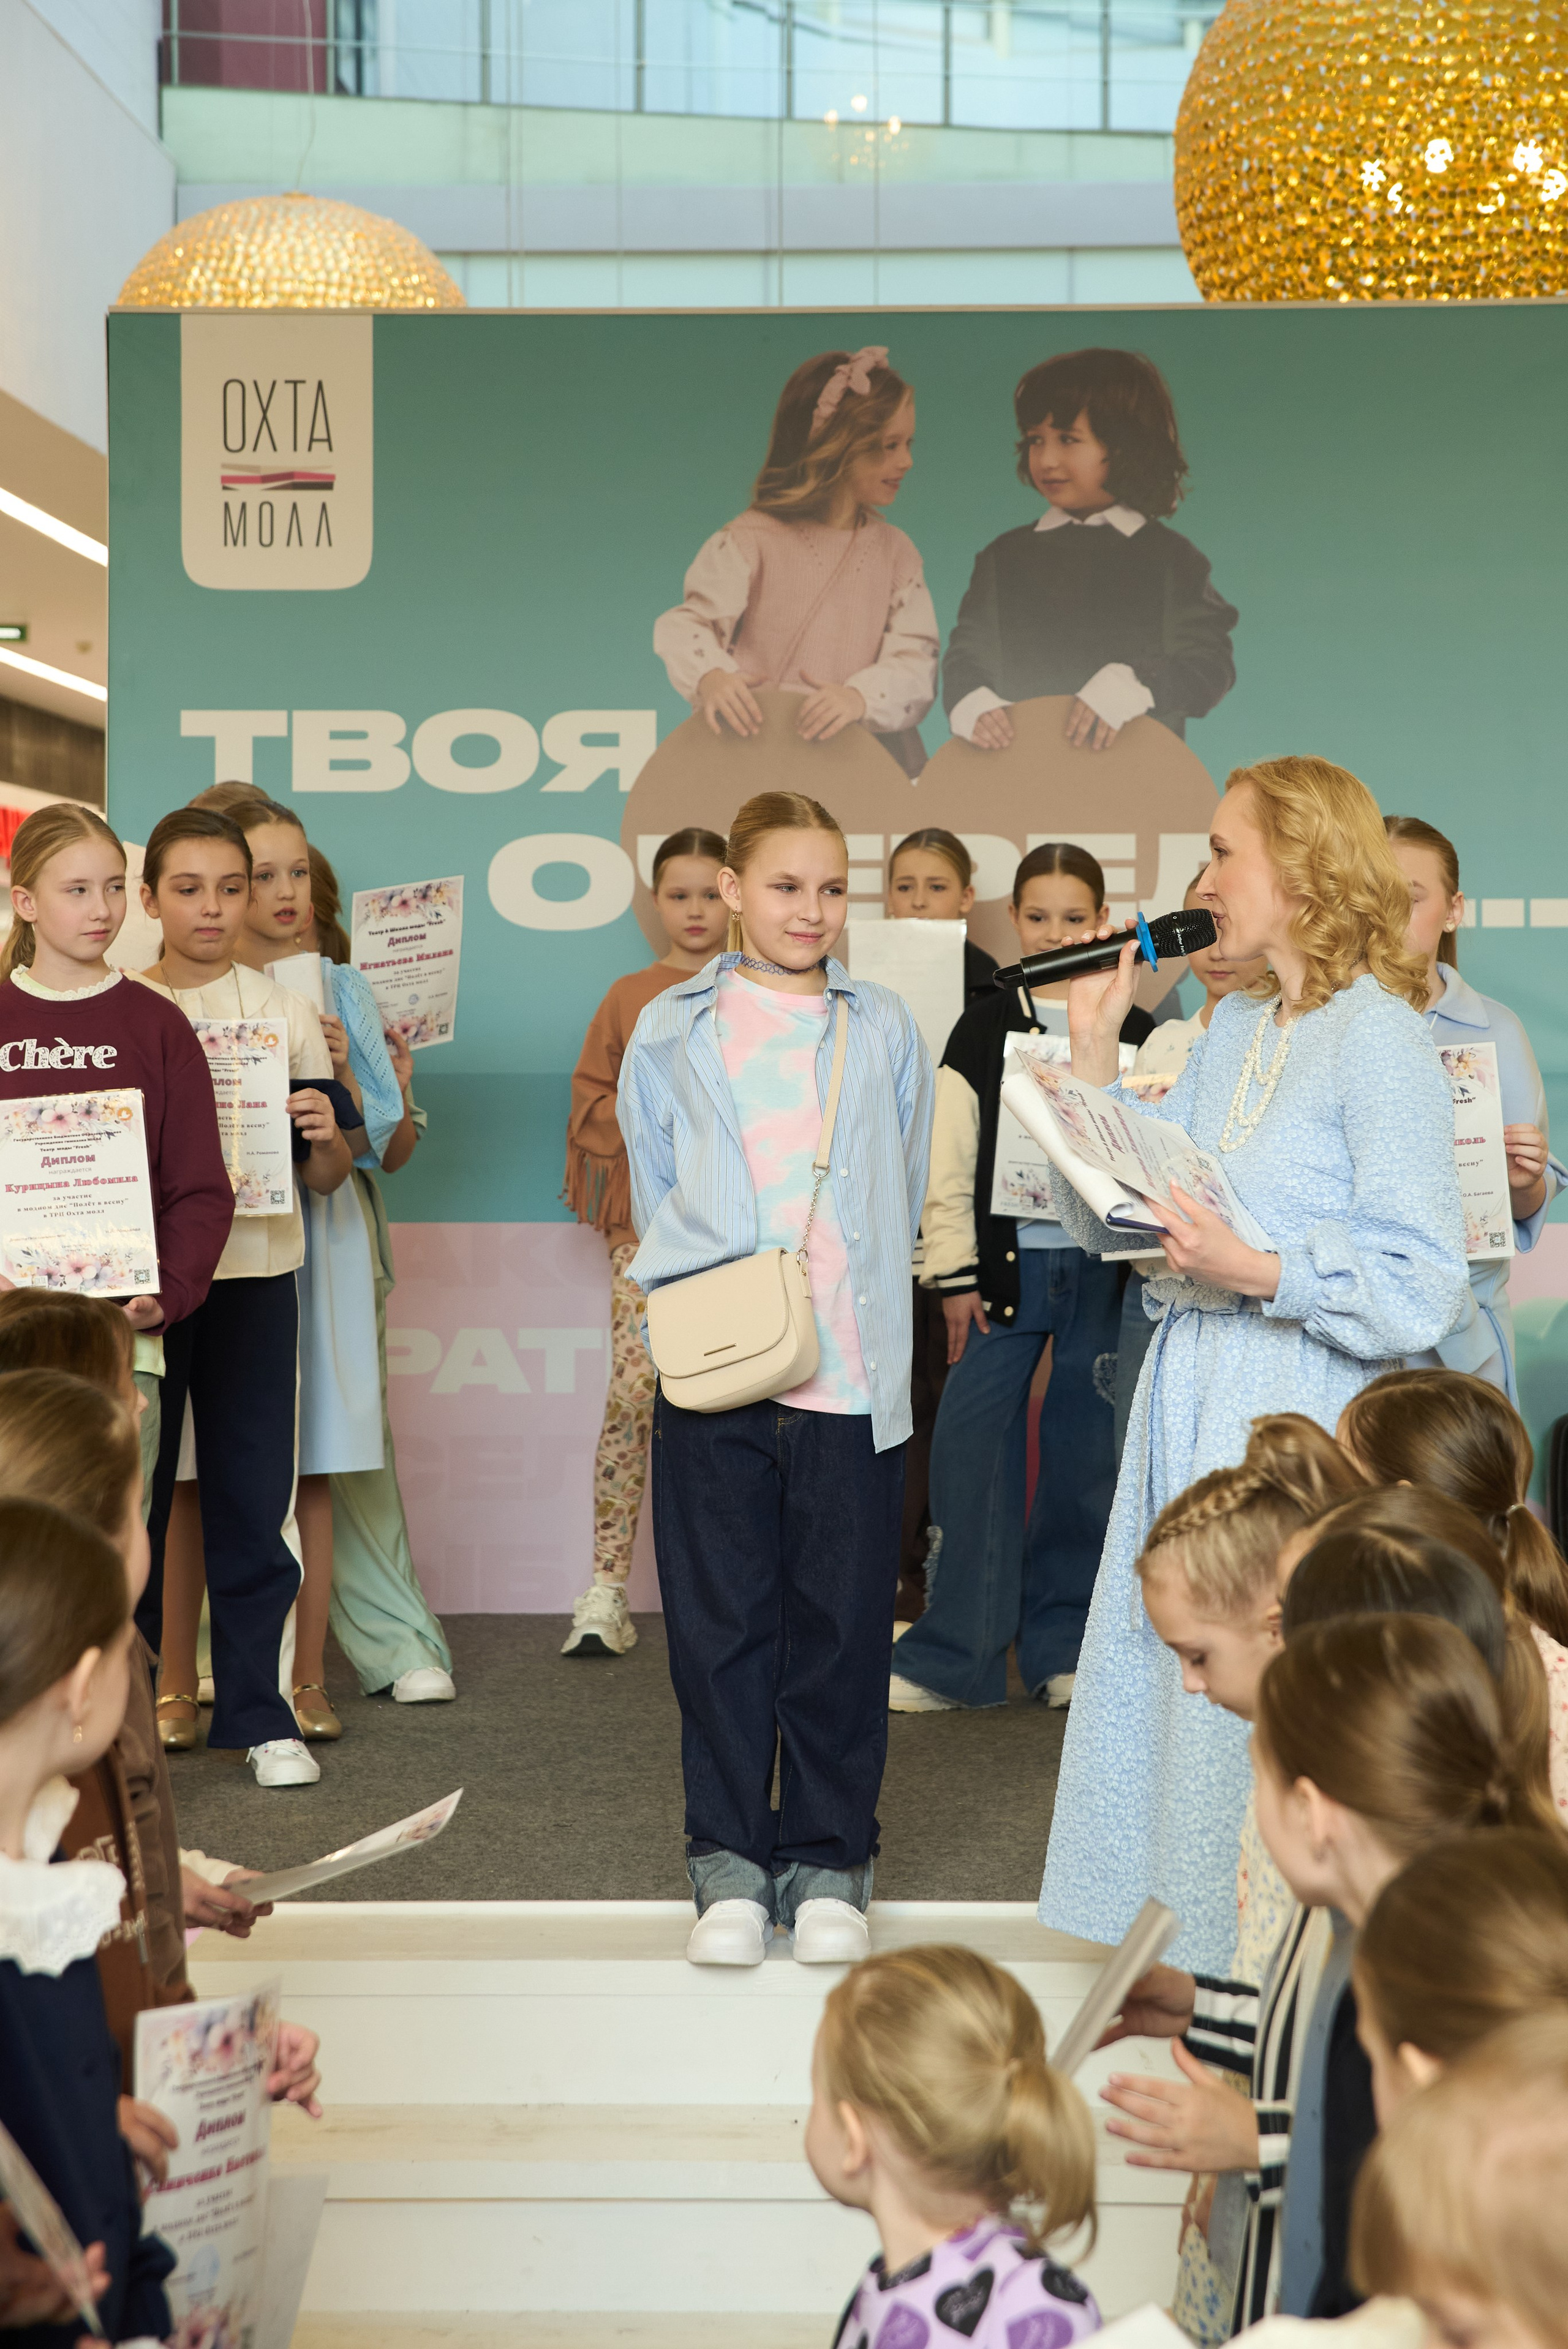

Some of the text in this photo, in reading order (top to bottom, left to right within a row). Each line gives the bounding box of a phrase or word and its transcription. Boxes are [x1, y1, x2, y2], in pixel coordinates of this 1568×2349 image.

[222, 379, 333, 453] ОХТА
[224, 501, 333, 548] МОЛЛ
[180, 708, 657, 794] ТВОЯ
[387, 933, 427, 948] Диплом
[0, 1037, 118, 1072] Chère
[40, 1154, 96, 1169] Диплом
[48, 1167, 92, 1175] награждается
[1458, 1159, 1483, 1167] весну"
[5, 1175, 138, 1194] Курицына Любомила
[194, 2109, 246, 2143] Диплом
